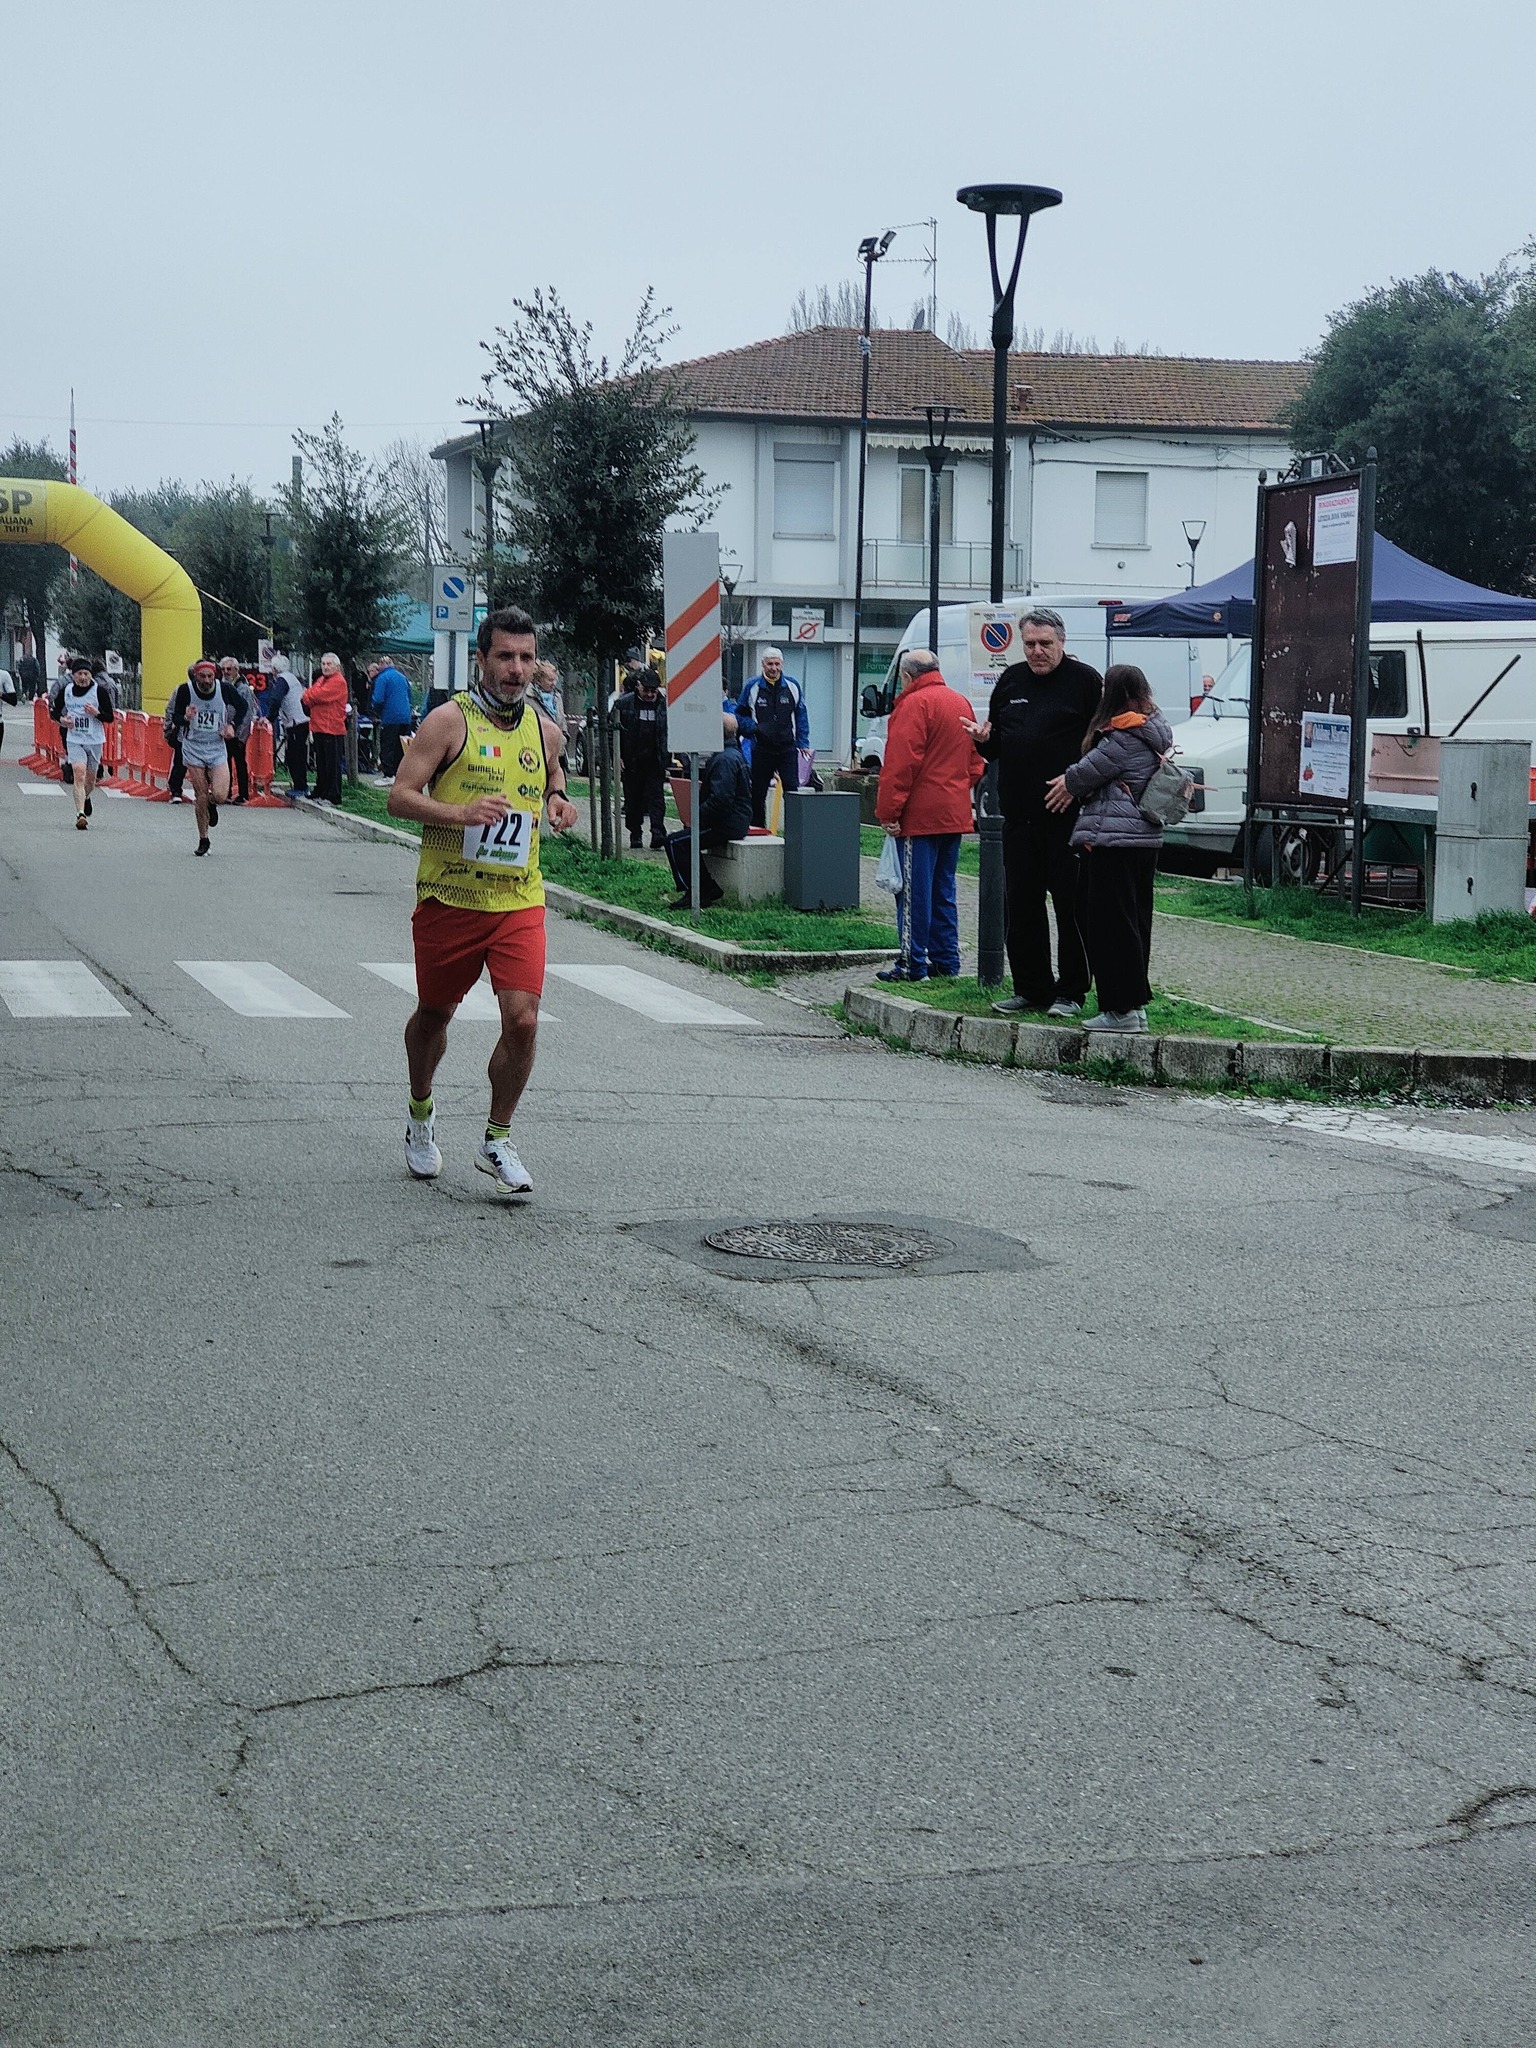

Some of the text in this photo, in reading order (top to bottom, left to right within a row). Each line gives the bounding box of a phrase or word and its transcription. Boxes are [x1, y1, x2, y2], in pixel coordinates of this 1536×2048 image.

[74, 716, 90, 728] 660
[197, 711, 215, 726] 524
[480, 813, 522, 846] 722
